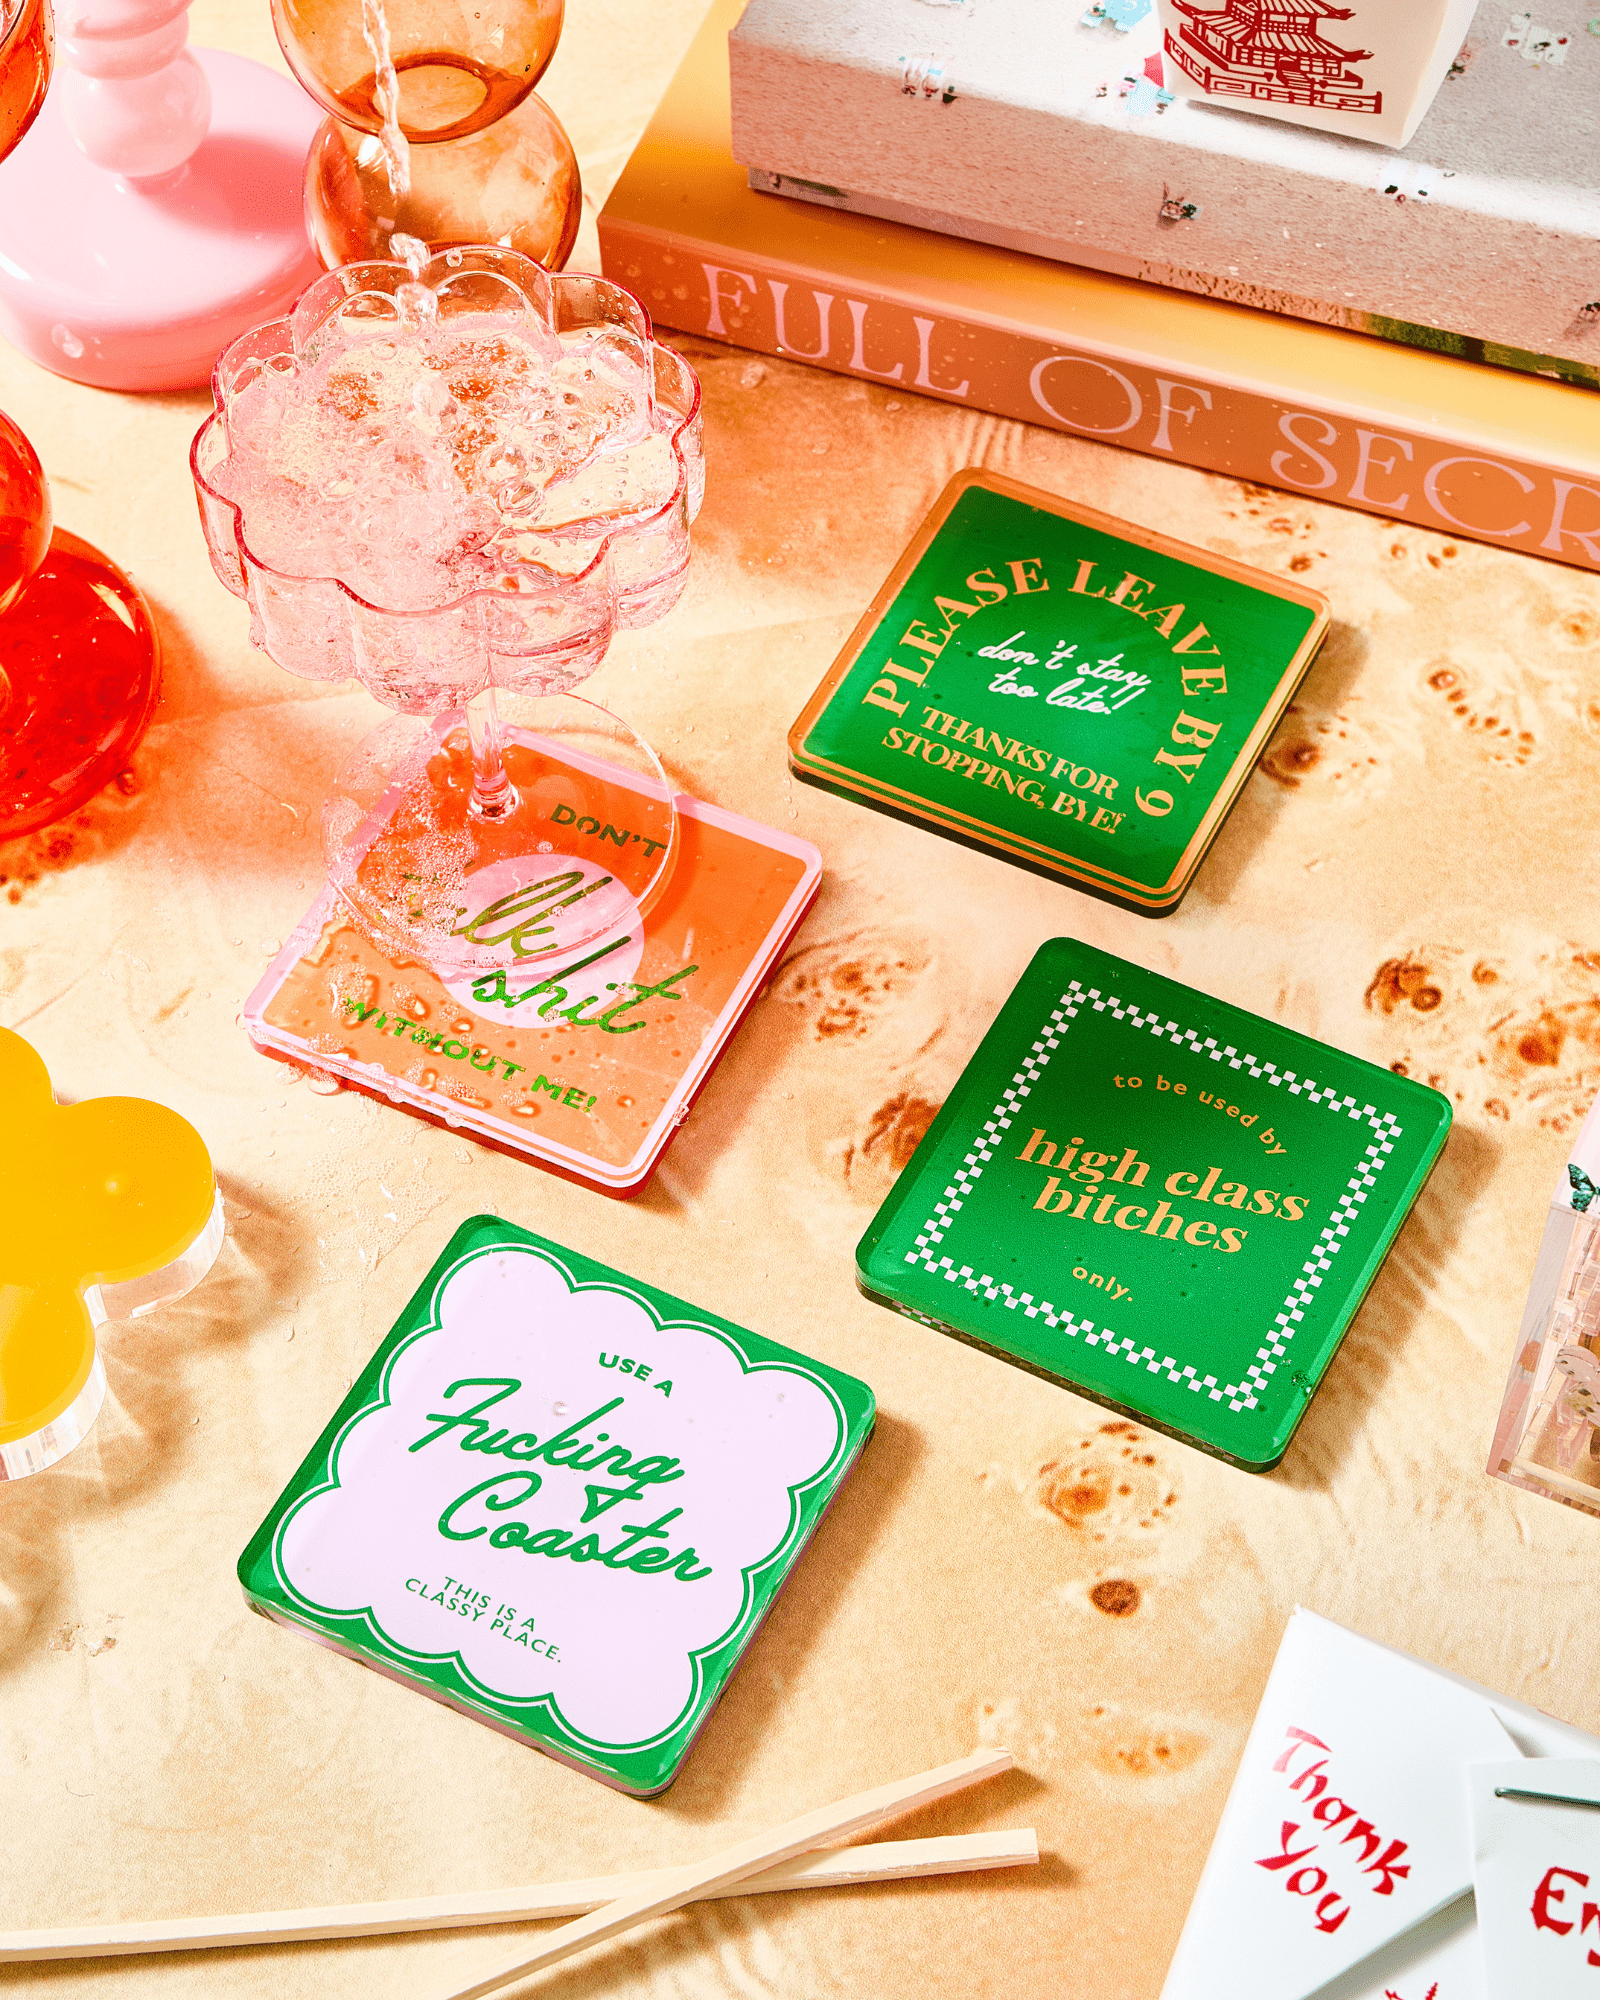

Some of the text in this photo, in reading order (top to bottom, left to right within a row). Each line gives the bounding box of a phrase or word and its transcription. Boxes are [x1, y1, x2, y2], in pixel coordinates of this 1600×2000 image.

[701, 263, 1600, 562] FULL OF SECR
[862, 557, 1228, 817] PLEASE LEAVE BY 9
[977, 630, 1152, 698] don't stay
[988, 666, 1146, 715] too late!
[882, 727, 1126, 834] STOPPING, BYE!
[920, 706, 1119, 800] THANKS FOR
[549, 803, 667, 858] DON'T
[471, 936, 699, 1034] shit
[345, 995, 598, 1114] WITHOUT ME!
[1113, 1074, 1287, 1156] to be used by
[1015, 1127, 1310, 1221] high class
[1033, 1176, 1248, 1253] bitches
[1072, 1266, 1133, 1302] only.
[598, 1352, 674, 1398] USE A
[408, 1378, 685, 1524] Fucking
[438, 1470, 713, 1582] Coaster
[405, 1578, 561, 1663] CLASSY PLACE.
[443, 1576, 535, 1632] THIS IS A
[1272, 1726, 1411, 1895] Thank
